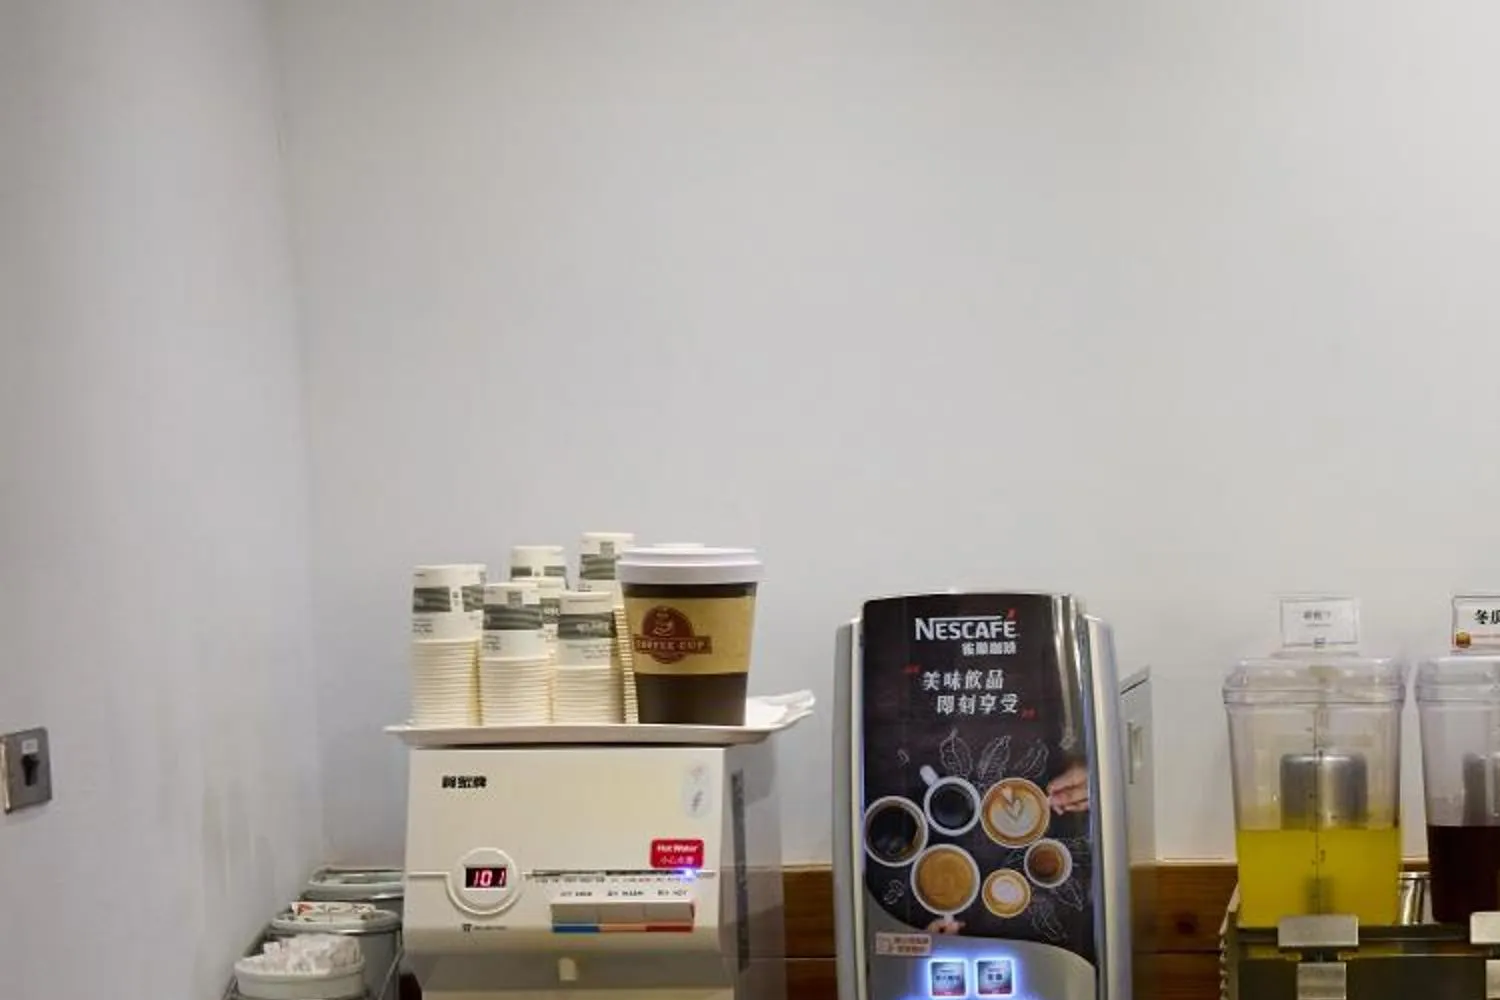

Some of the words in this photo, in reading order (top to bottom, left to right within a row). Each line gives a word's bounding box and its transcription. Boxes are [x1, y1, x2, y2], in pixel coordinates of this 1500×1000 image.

[922, 669, 1005, 691] 美味飲品
[936, 693, 1019, 715] 即刻享受
